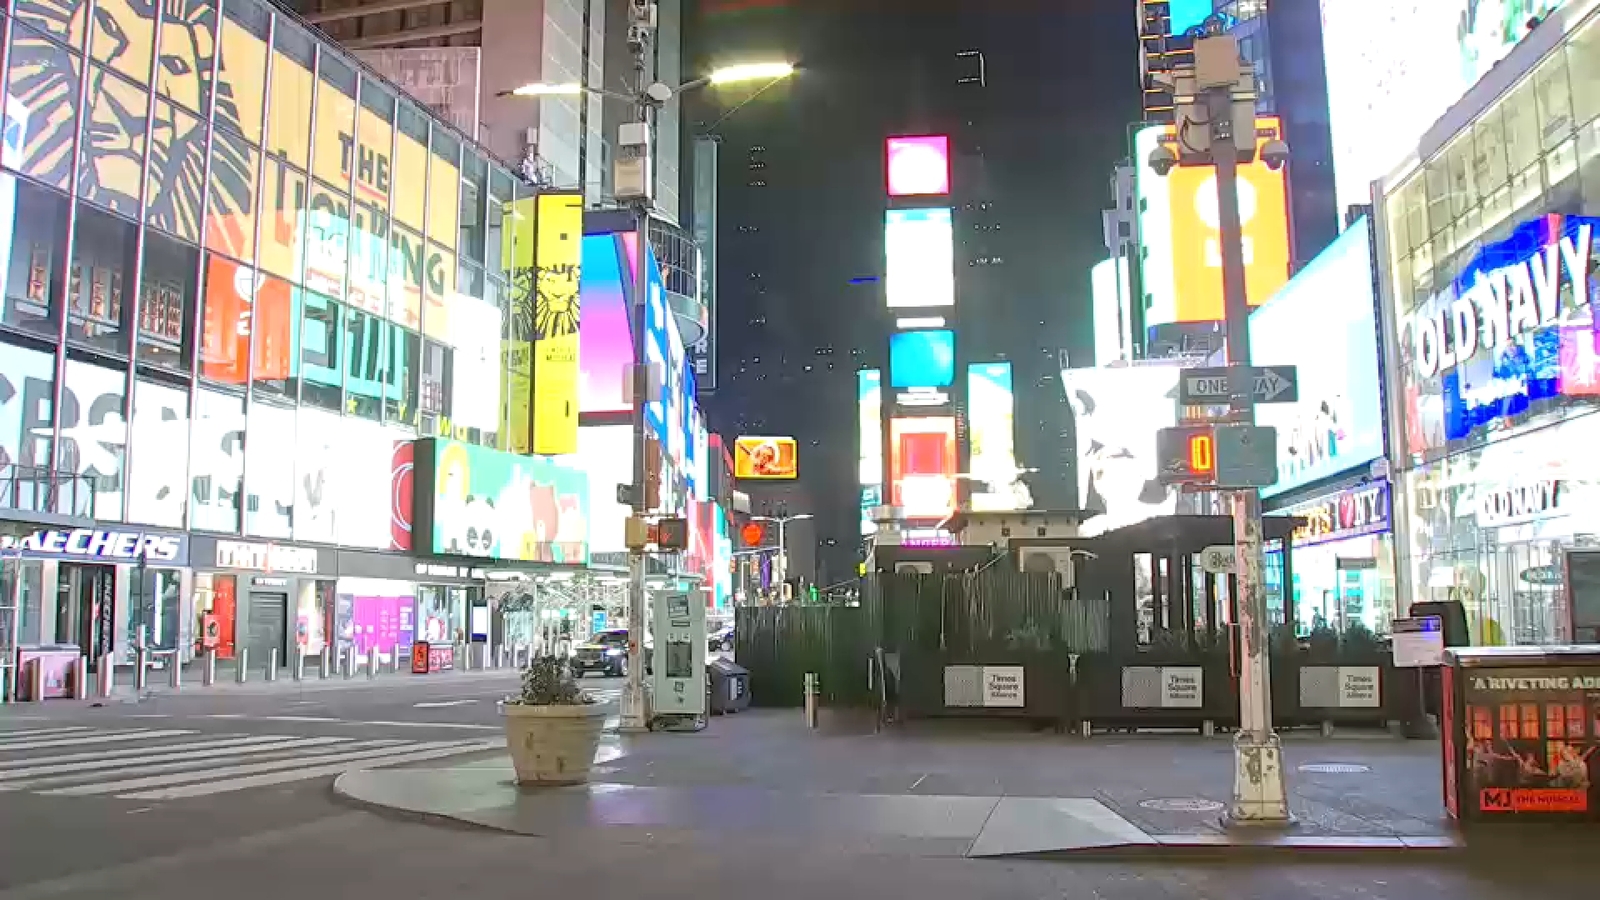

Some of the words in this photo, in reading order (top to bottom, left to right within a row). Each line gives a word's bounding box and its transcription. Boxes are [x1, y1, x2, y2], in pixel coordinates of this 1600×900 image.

[338, 130, 389, 194] THE
[1416, 299, 1476, 378] OLD
[1473, 223, 1592, 349] NAVY
[1196, 379, 1228, 394] ONE
[1489, 677, 1570, 689] RIVETING
[1485, 792, 1511, 808] MJ
